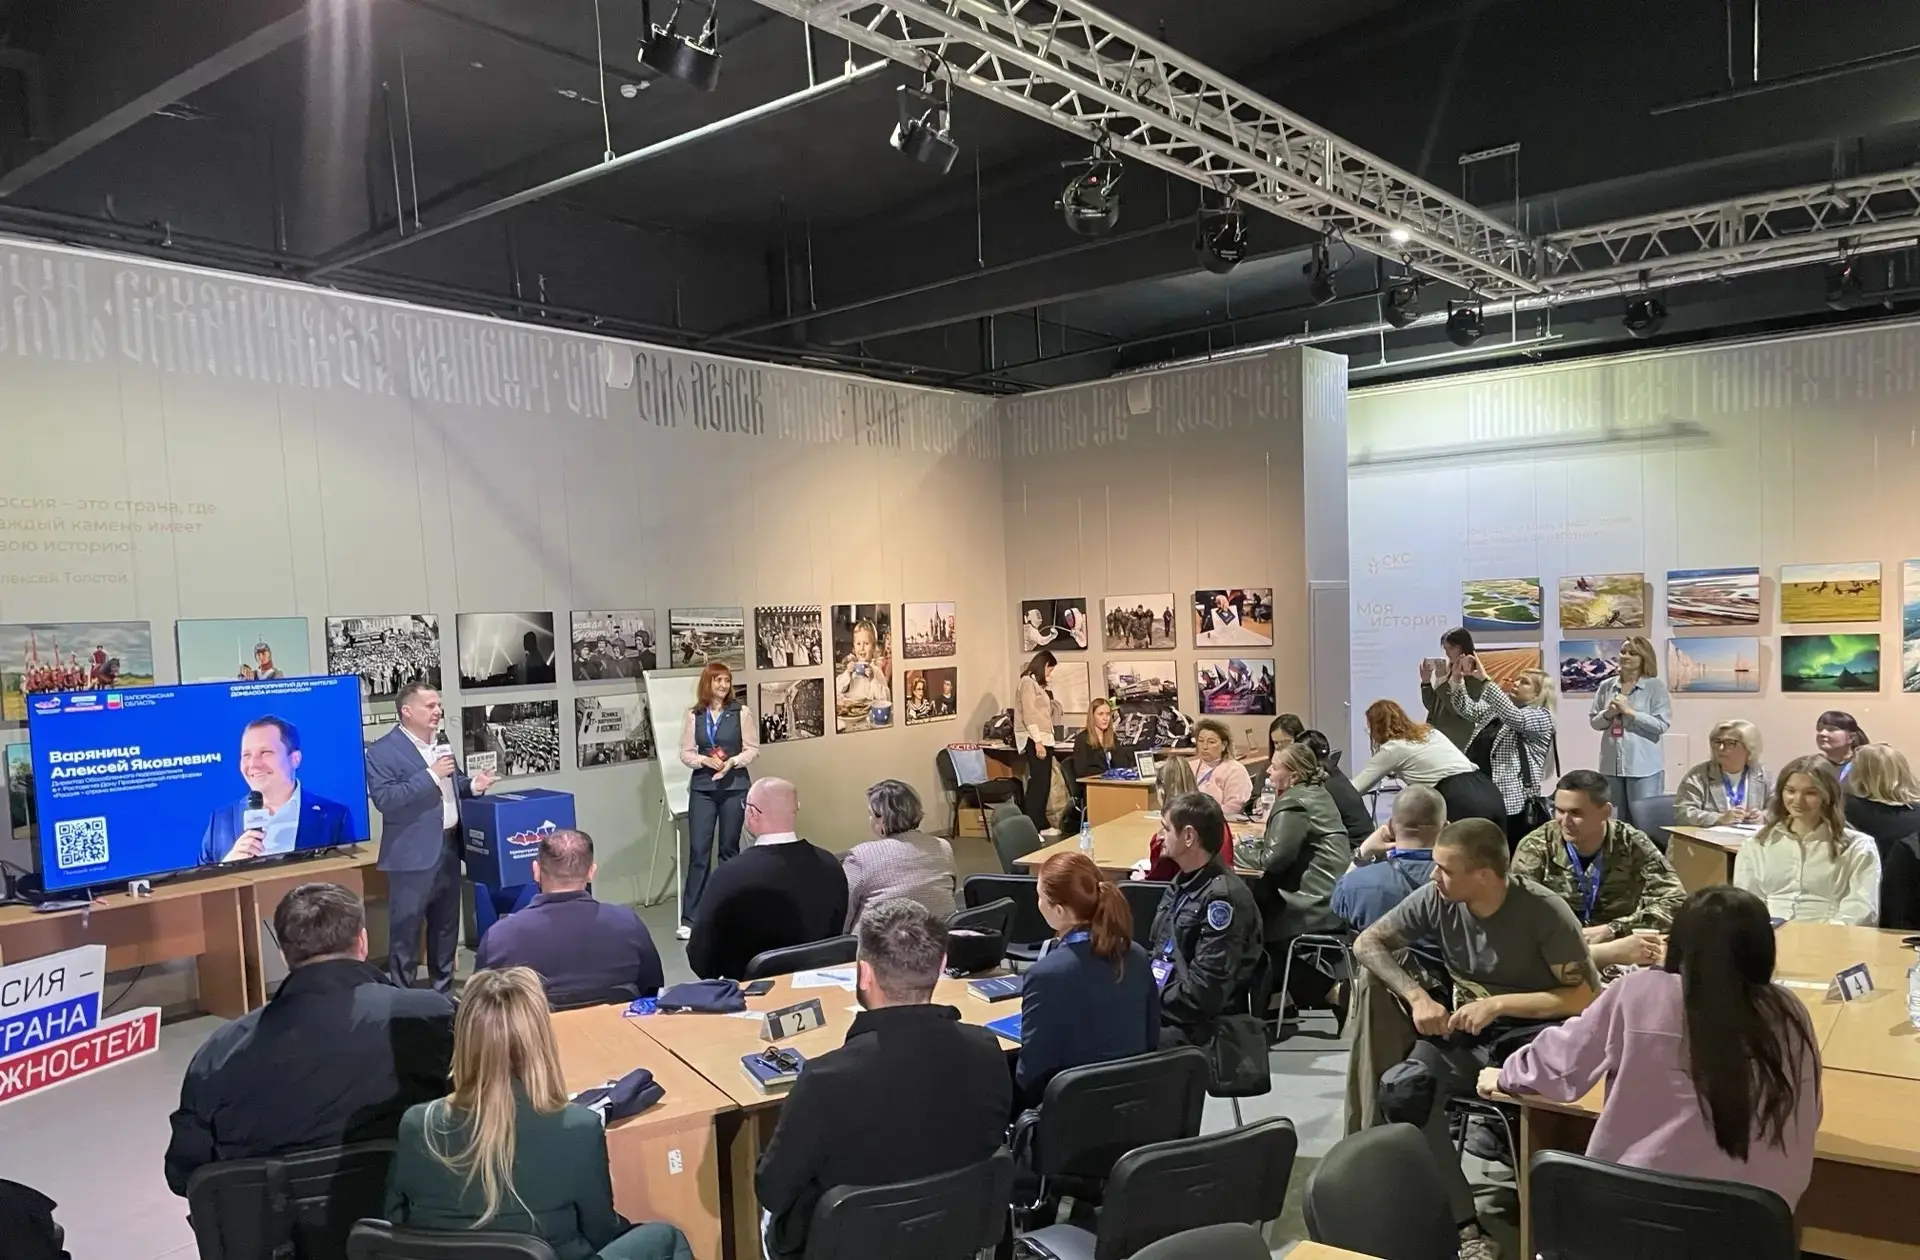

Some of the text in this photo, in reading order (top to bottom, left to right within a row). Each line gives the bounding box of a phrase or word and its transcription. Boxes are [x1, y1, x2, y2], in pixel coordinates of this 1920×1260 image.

[77, 499, 109, 511] это
[188, 501, 218, 516] где
[72, 519, 142, 533] камень
[148, 520, 203, 534] имеет
[1382, 552, 1412, 566] СКС
[63, 570, 128, 585] Толстой
[1357, 600, 1394, 616] Моя
[1371, 612, 1448, 629] история
[124, 692, 175, 701] ЗАПОРОЖСКАЯ
[124, 700, 156, 708] ОБЛАСТЬ
[49, 745, 141, 764] Варяница
[51, 752, 222, 779] Алексей Яковлевич
[1, 966, 66, 1007] СИЯ
[1854, 975, 1864, 994] 4
[792, 1012, 806, 1032] 2
